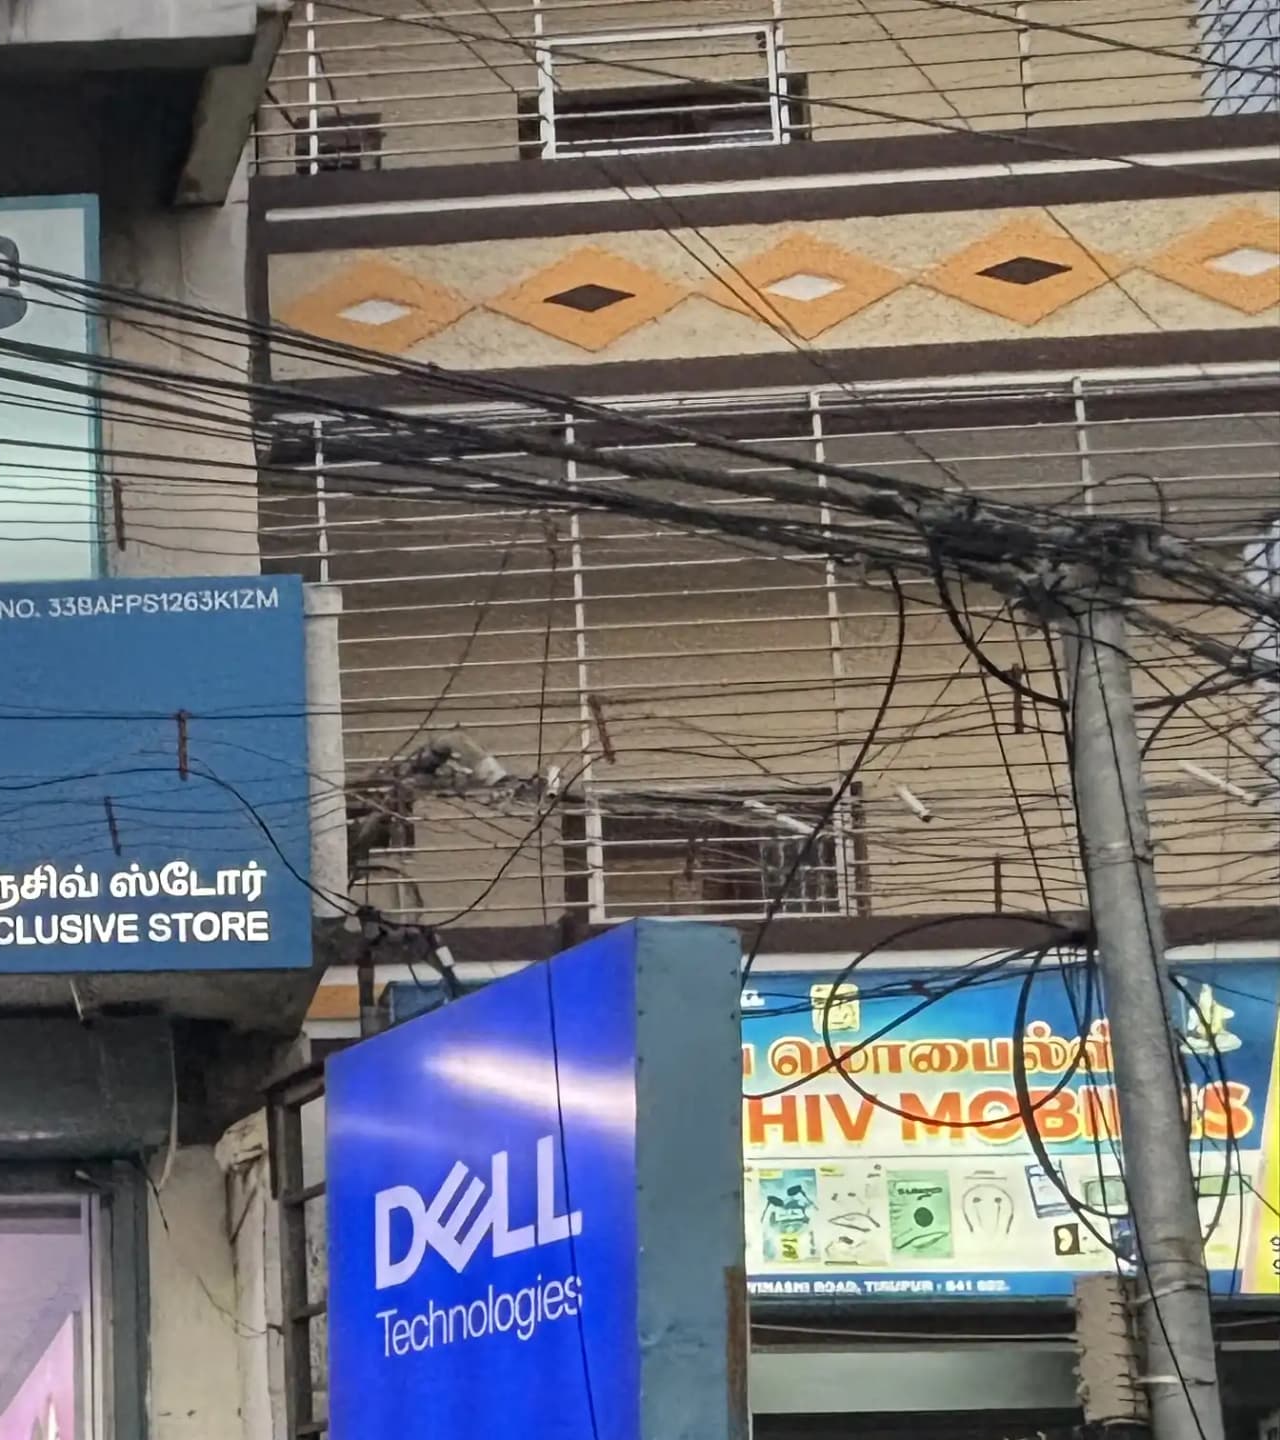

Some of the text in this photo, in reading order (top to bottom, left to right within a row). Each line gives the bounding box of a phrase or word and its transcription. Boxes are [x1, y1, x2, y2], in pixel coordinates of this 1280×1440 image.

[108, 860, 268, 902] ஸ்டோர்
[147, 910, 270, 942] STORE
[747, 1078, 1254, 1146] HIV MOBIS
[374, 1134, 584, 1291] DELL
[375, 1273, 584, 1358] Technologies
